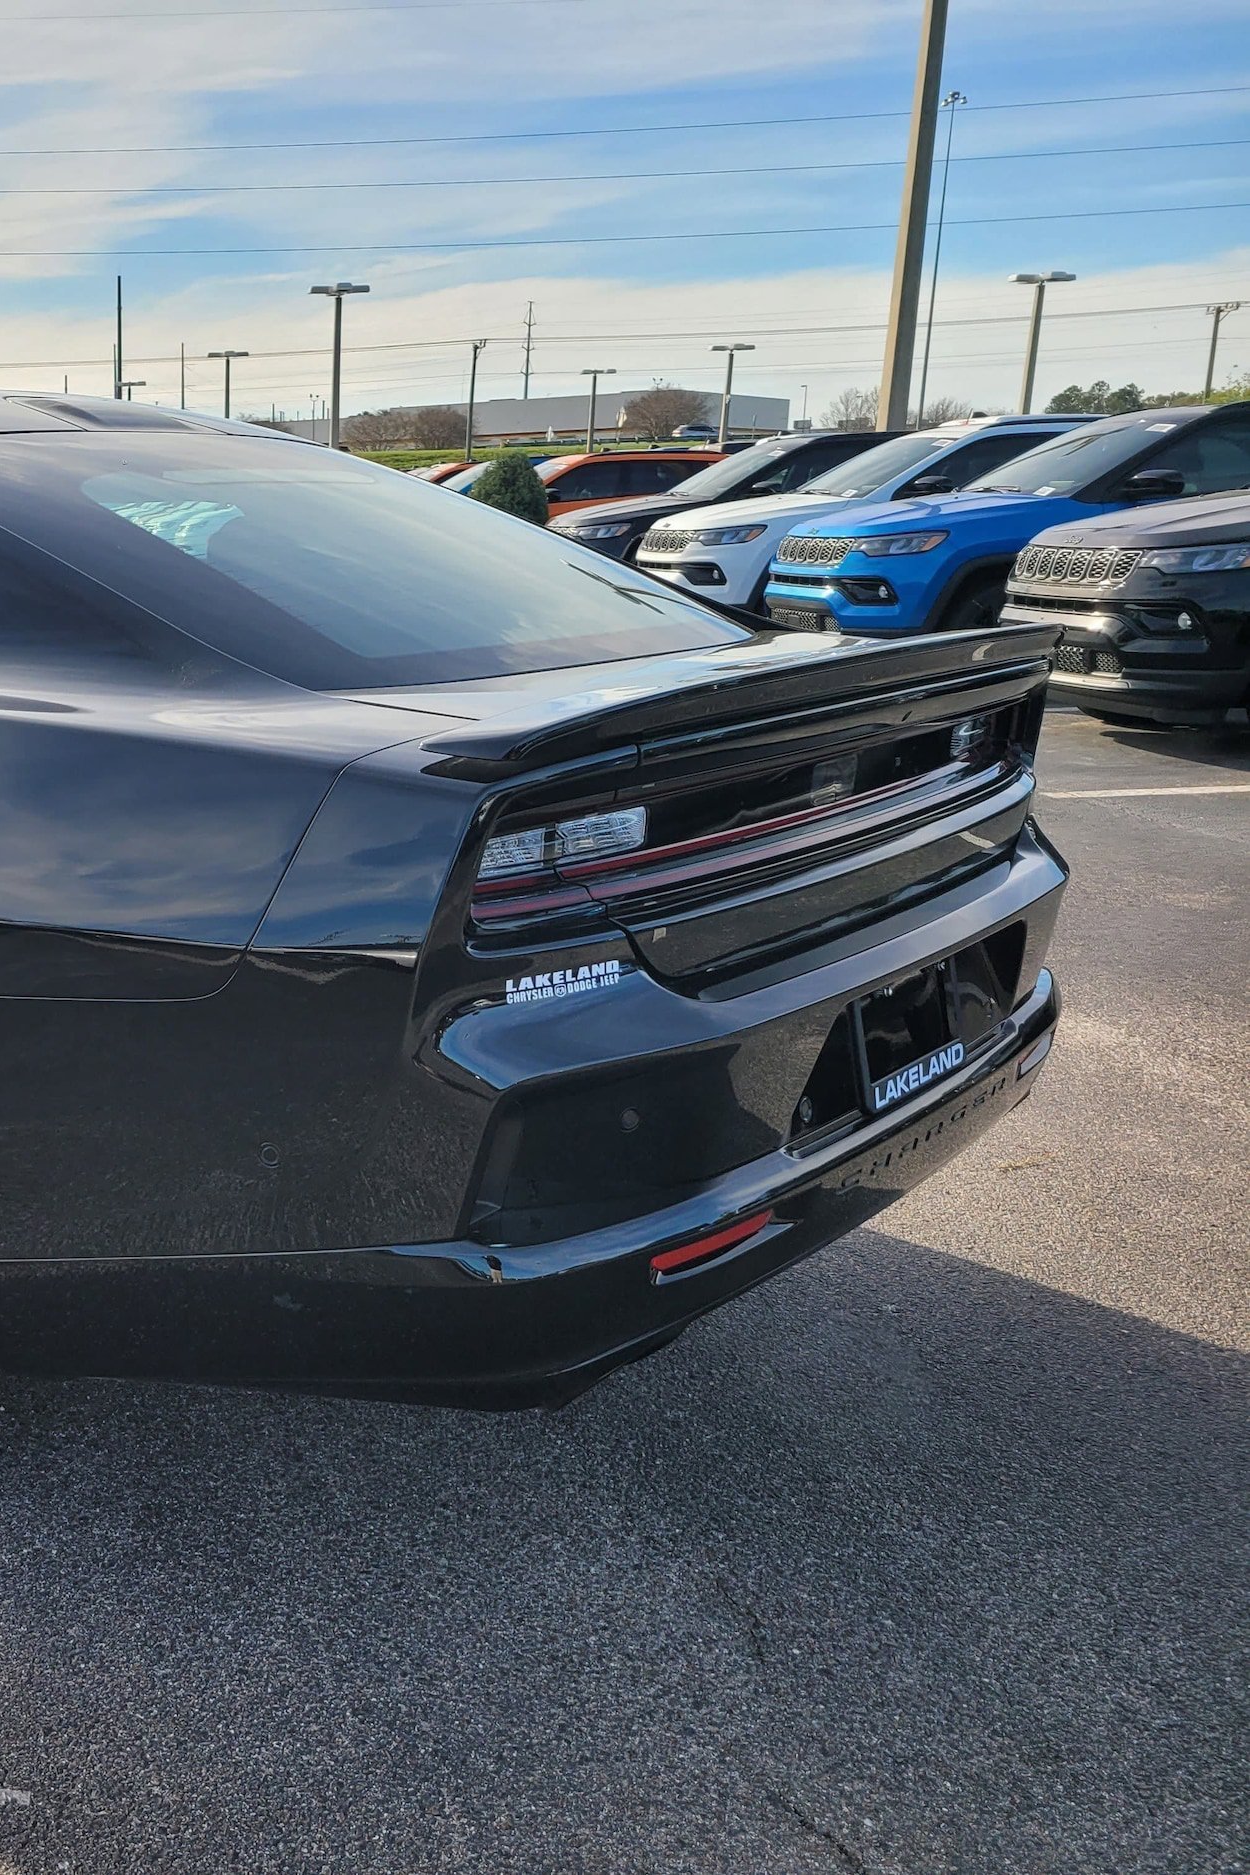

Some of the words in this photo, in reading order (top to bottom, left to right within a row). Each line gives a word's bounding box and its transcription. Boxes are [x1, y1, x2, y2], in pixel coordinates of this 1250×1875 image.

[505, 960, 620, 993] LAKELAND
[506, 986, 554, 1004] CHRYSLER
[567, 977, 597, 994] DODGE
[600, 973, 620, 987] JEEP
[873, 1042, 965, 1110] LAKELAND
